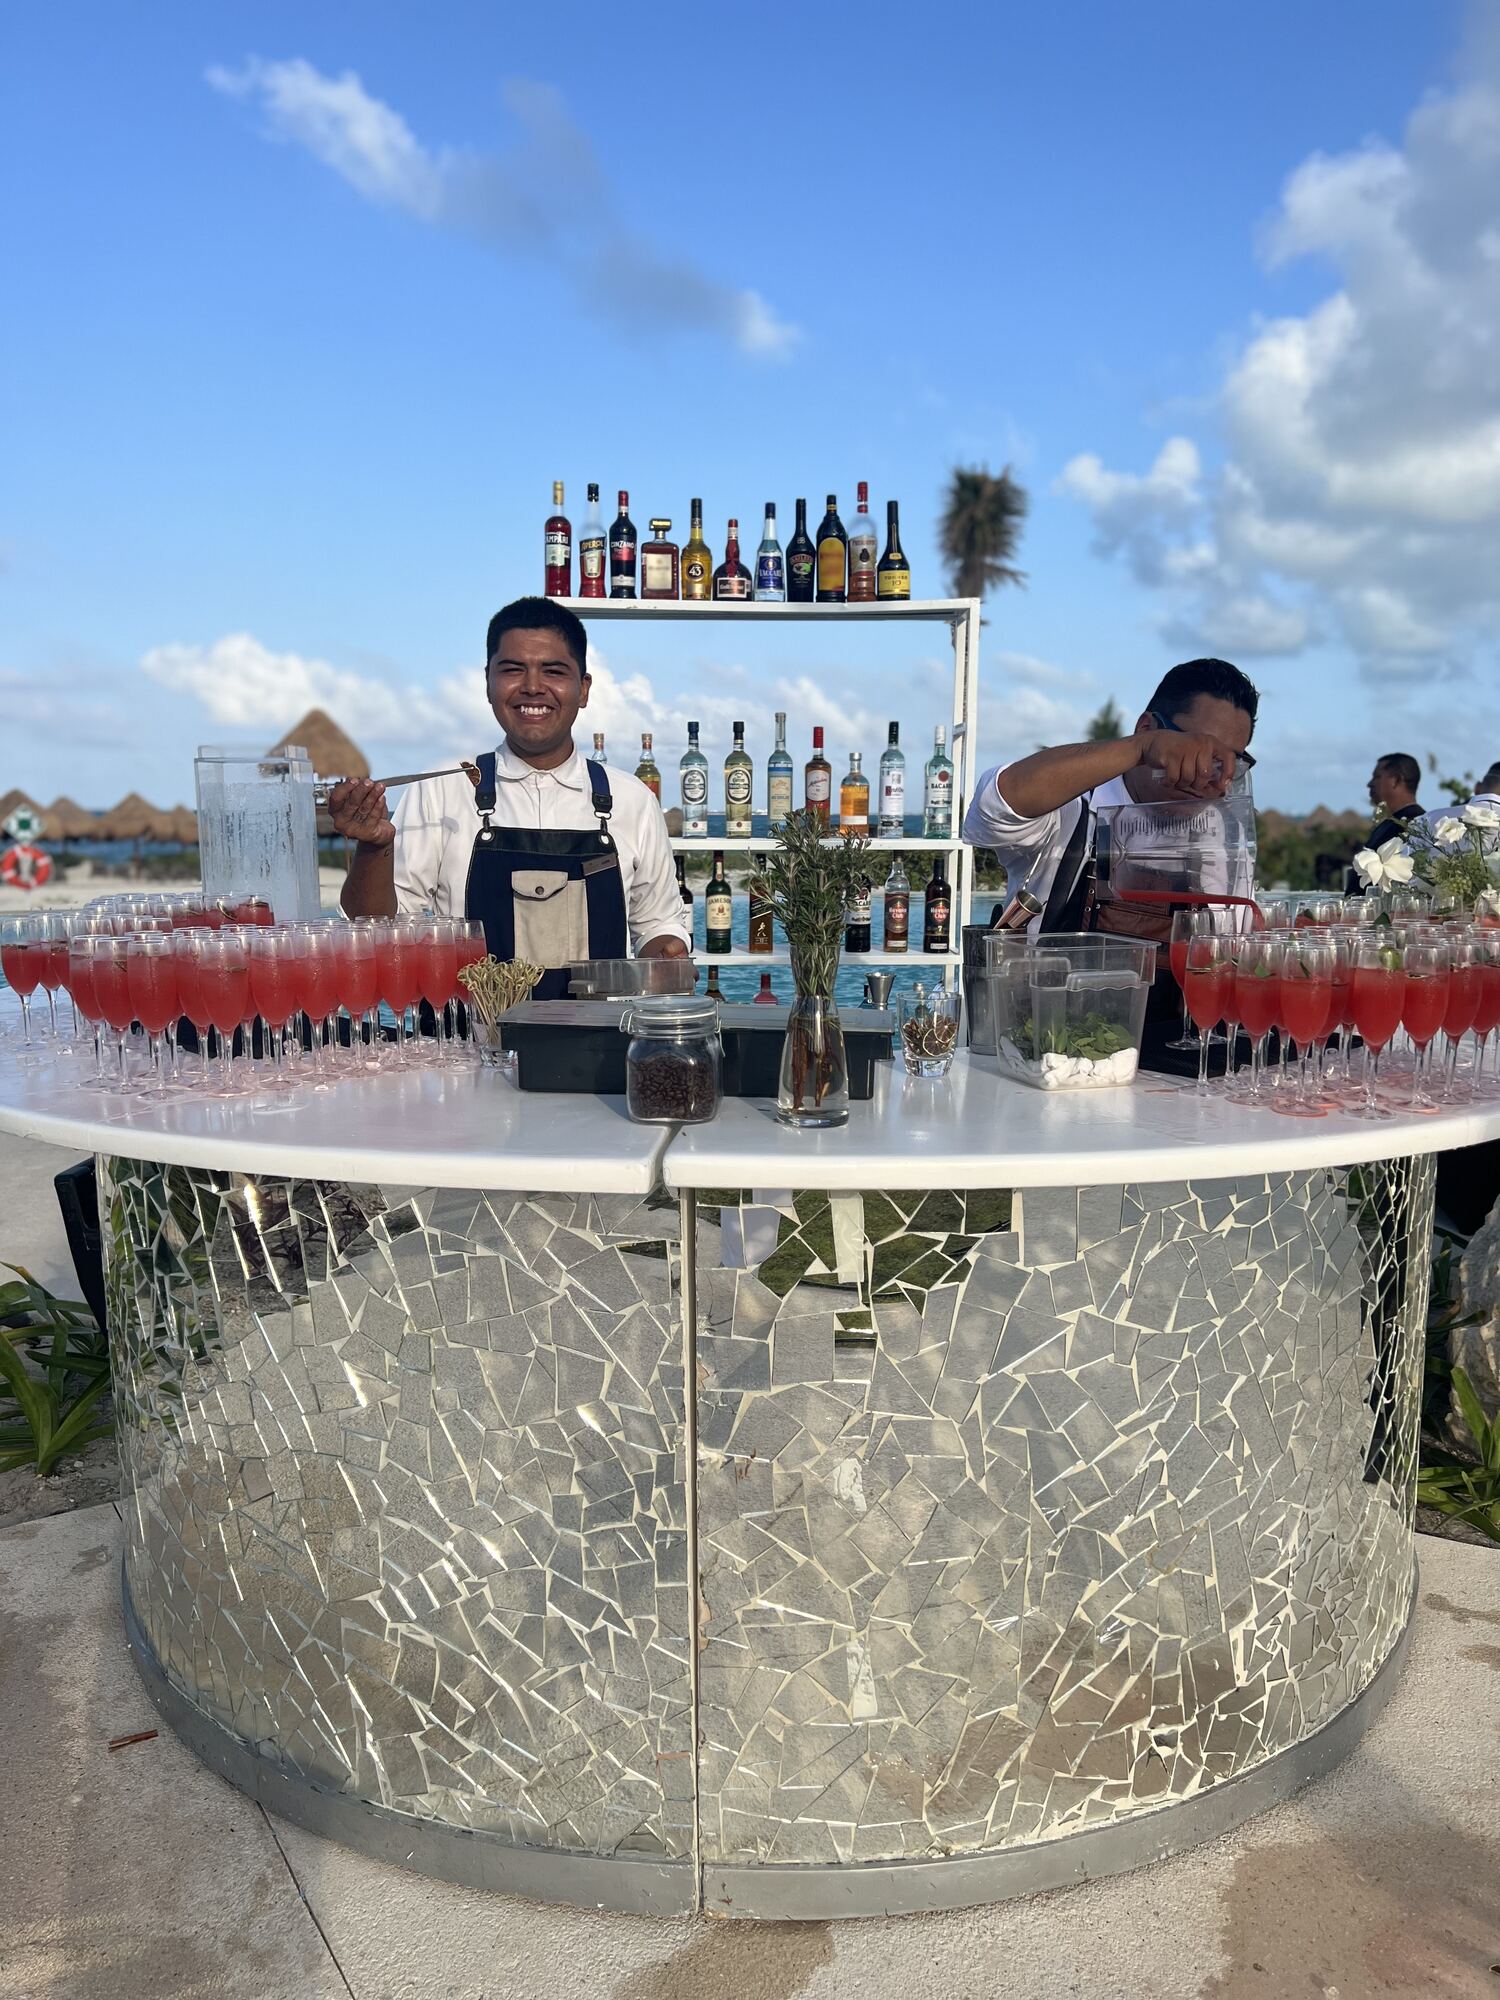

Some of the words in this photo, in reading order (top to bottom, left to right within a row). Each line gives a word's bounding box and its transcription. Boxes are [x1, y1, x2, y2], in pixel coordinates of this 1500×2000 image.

[545, 535, 569, 544] AMPARI
[611, 540, 634, 549] CINZANO
[581, 540, 604, 551] APEROL
[689, 566, 702, 577] 43
